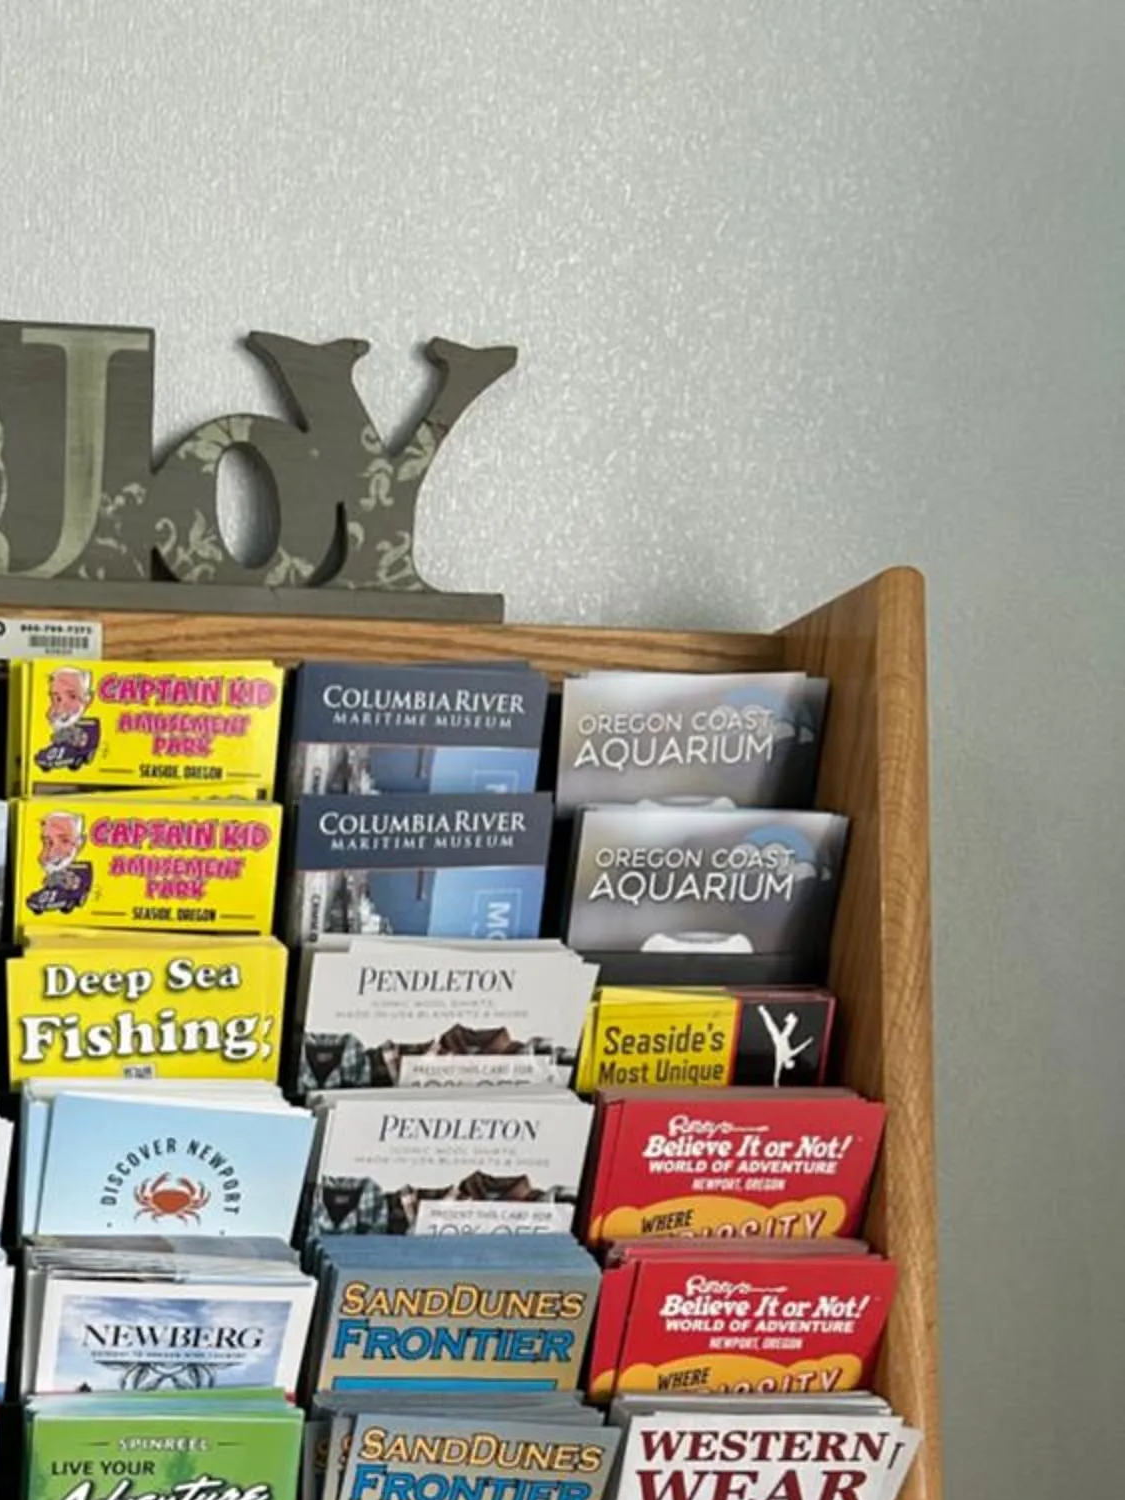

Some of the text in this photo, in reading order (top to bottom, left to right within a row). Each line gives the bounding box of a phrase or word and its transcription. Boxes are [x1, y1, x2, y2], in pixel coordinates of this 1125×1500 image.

[97, 673, 274, 706] CAPTAIN KID
[117, 712, 251, 737] AMUSEMENT
[333, 712, 513, 729] MARITIME MUSEUM
[579, 709, 773, 737] OREGON COAST
[151, 735, 214, 757] PARK
[574, 734, 774, 770] AQUARIUM
[45, 959, 240, 999] Deep Sea
[358, 967, 516, 995] PENDLETON
[603, 1024, 725, 1056] Seaside's
[599, 1060, 724, 1086] Most Unique
[643, 1135, 853, 1159] Believe It or Not!
[100, 1137, 241, 1215] DISCOVER NEWPORT
[649, 1161, 837, 1174] WORLD OF ADVENTURE
[641, 1208, 694, 1233] WHERE
[83, 1325, 264, 1349] NEWBERG
[333, 1319, 575, 1363] FRONTIER
[118, 1436, 210, 1452] SPINREEL
[640, 1430, 889, 1463] WESTERN
[51, 1460, 155, 1478] LIVE YOUR
